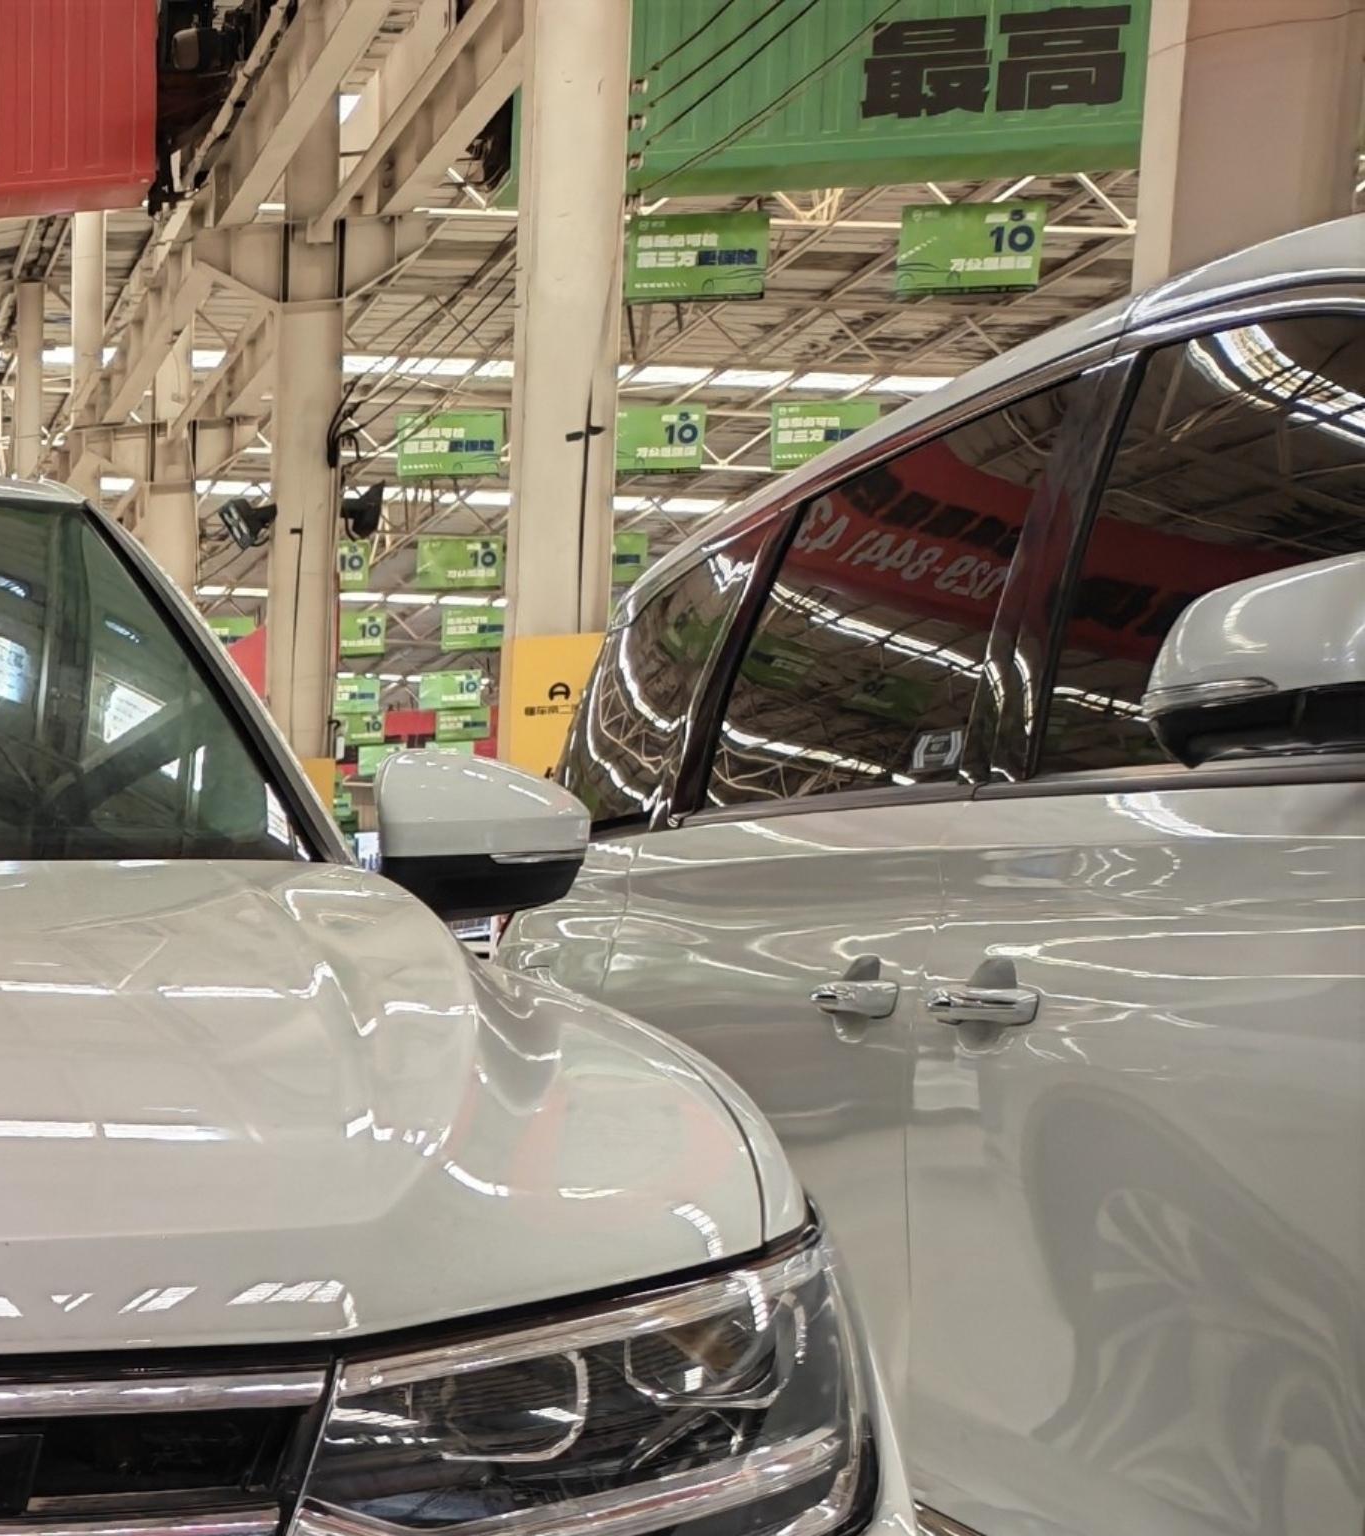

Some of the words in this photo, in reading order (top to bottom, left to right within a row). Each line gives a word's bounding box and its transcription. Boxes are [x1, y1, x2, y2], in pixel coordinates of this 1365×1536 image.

[861, 5, 1132, 118] 最高
[989, 225, 1035, 253] 10
[664, 423, 699, 445] 10
[470, 550, 497, 568] 10
